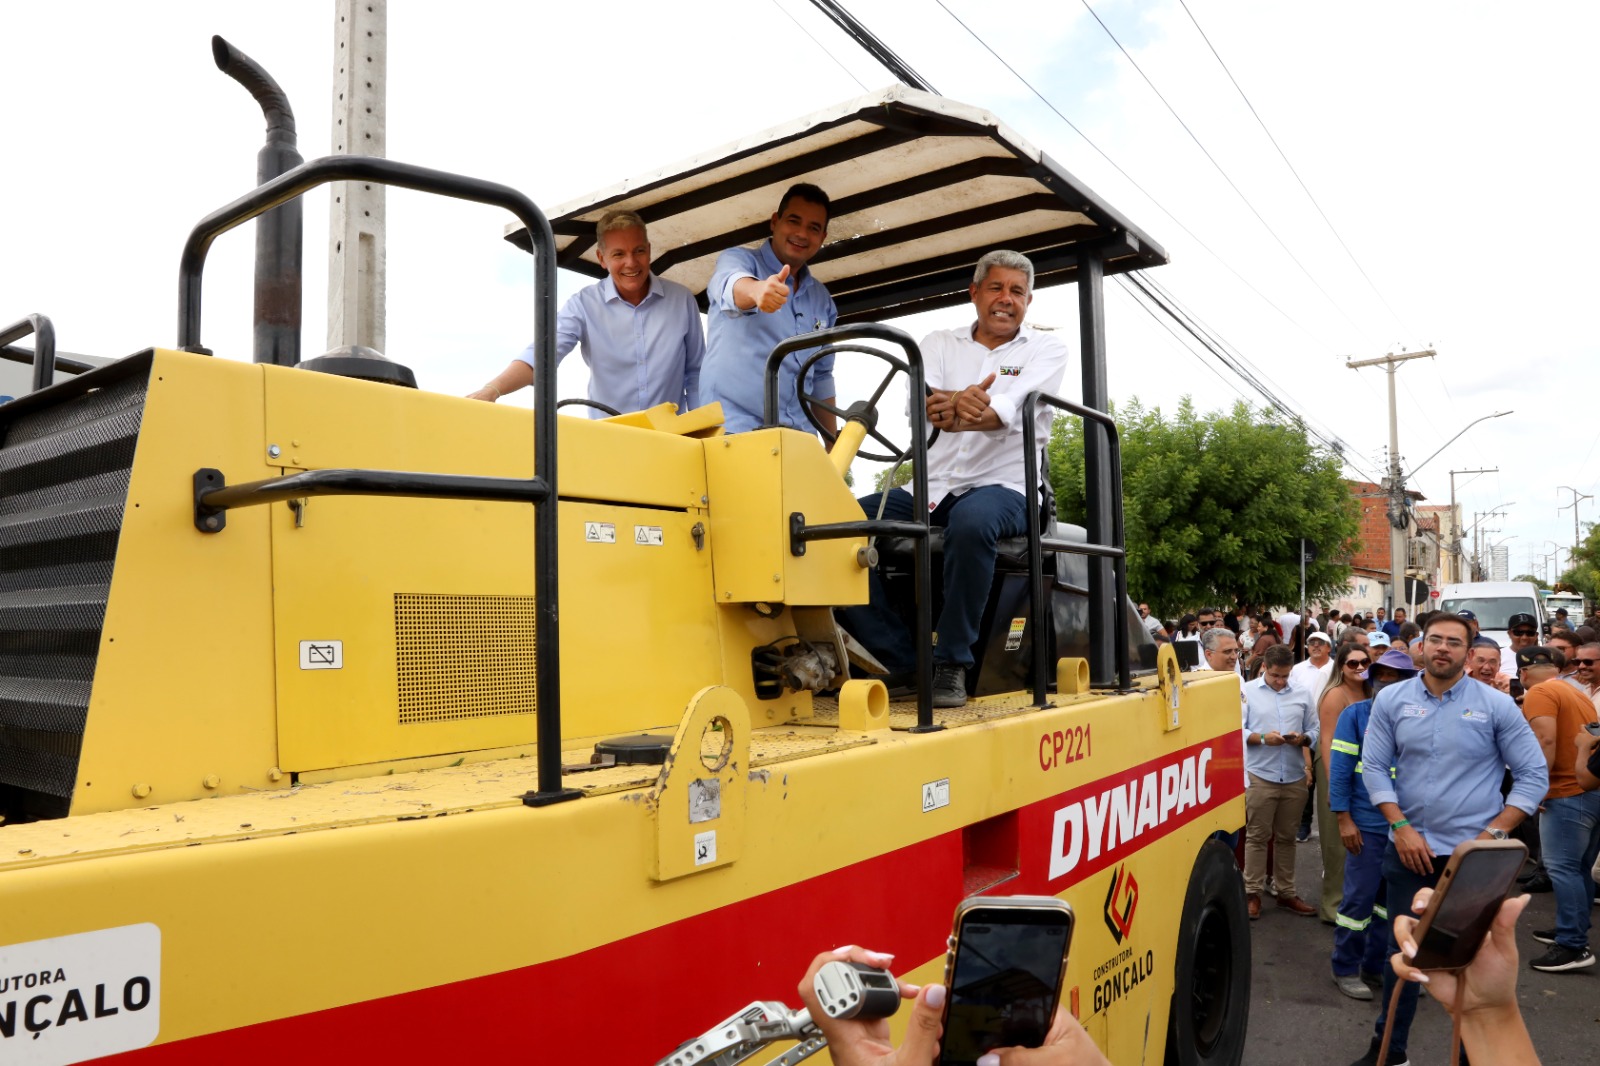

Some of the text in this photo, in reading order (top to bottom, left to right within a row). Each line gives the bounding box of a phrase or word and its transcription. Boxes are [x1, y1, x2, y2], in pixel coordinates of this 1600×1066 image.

[1039, 723, 1091, 771] CP221
[1048, 747, 1212, 881] DYNAPAC
[1093, 946, 1133, 981] CONSTRUTORA
[1093, 949, 1153, 1013] GONÇALO
